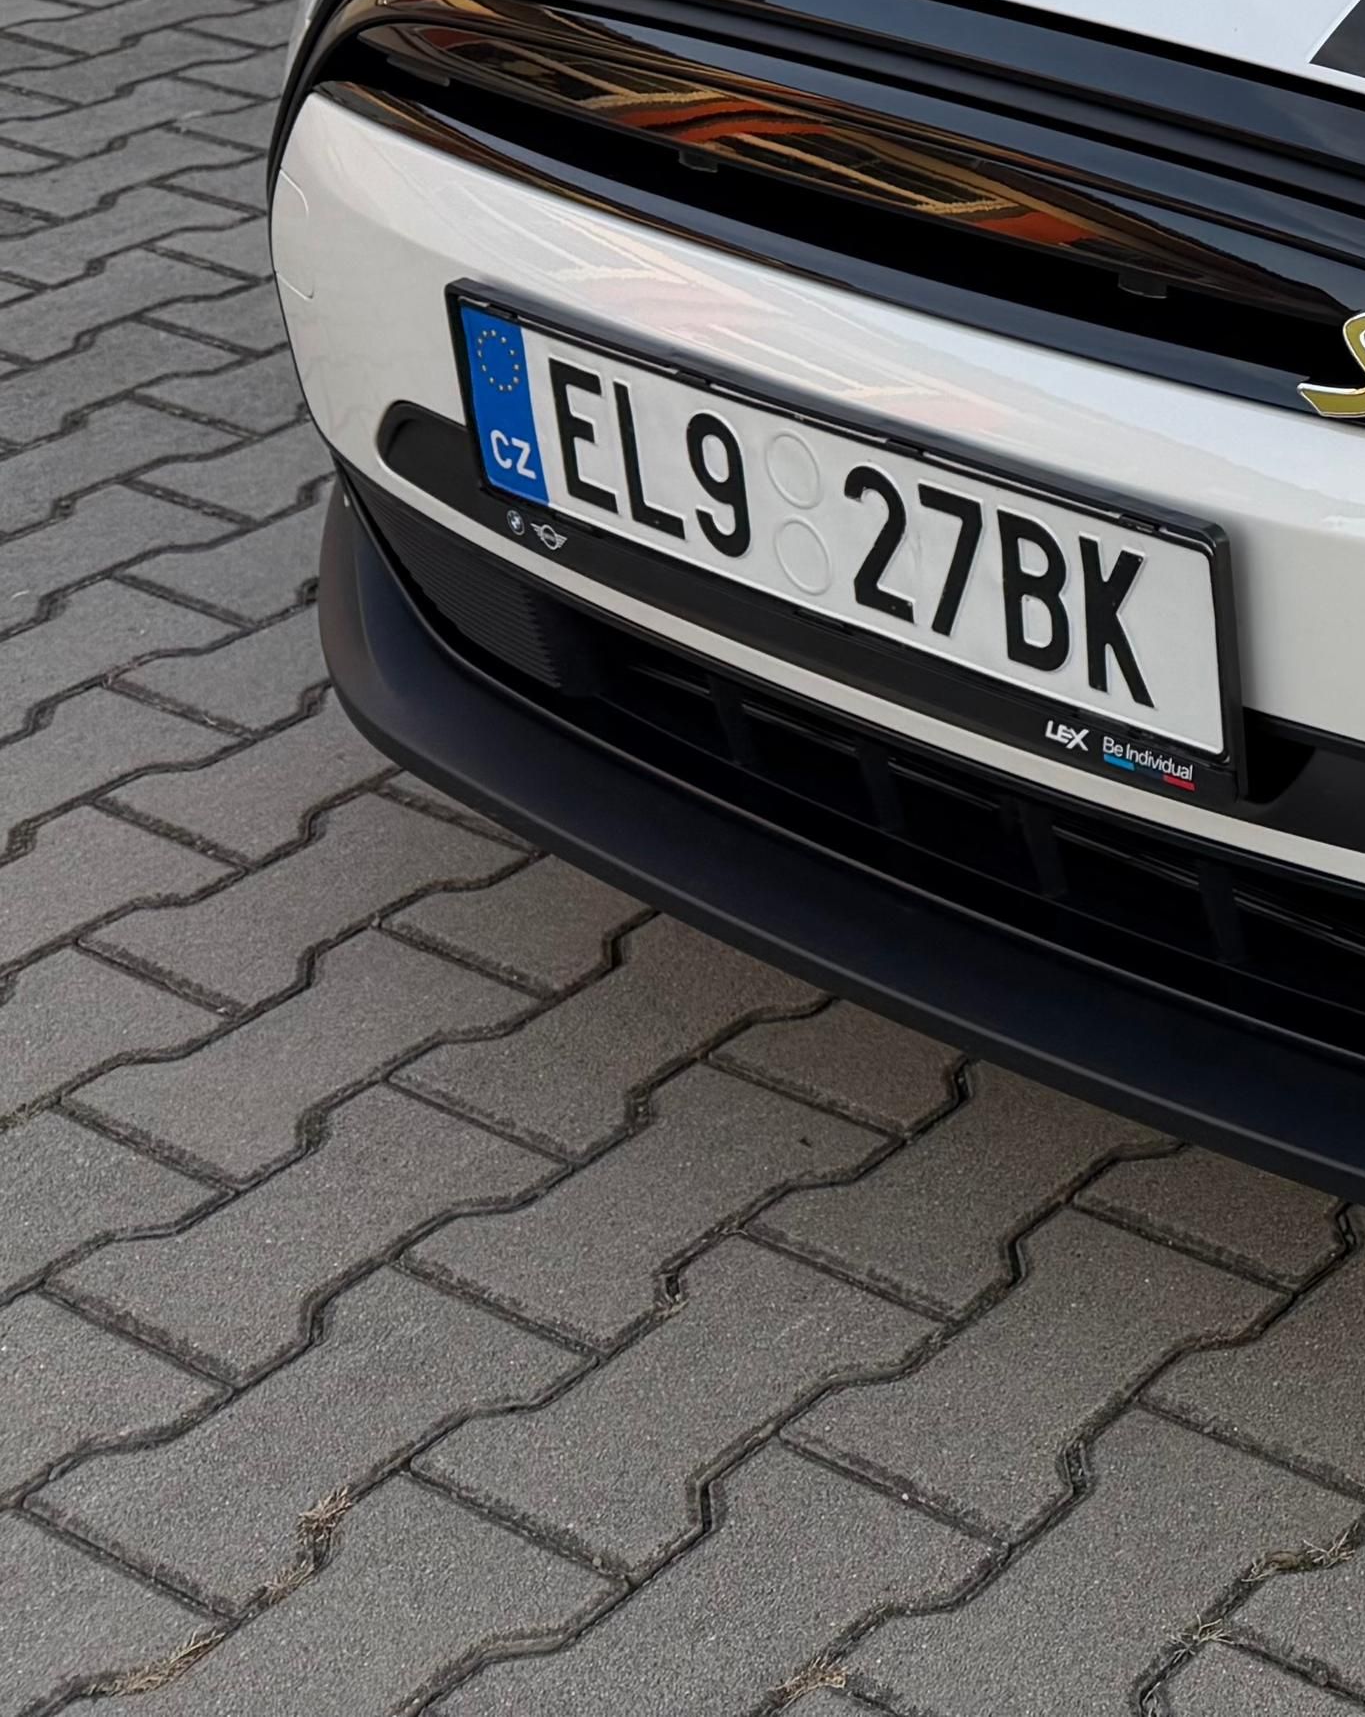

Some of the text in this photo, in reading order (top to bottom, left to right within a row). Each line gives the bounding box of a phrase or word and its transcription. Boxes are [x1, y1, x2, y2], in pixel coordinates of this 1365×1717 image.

[489, 428, 537, 481] CZ
[547, 355, 1156, 710] EL9 27BK
[1044, 719, 1193, 781] LEX Be Individual
